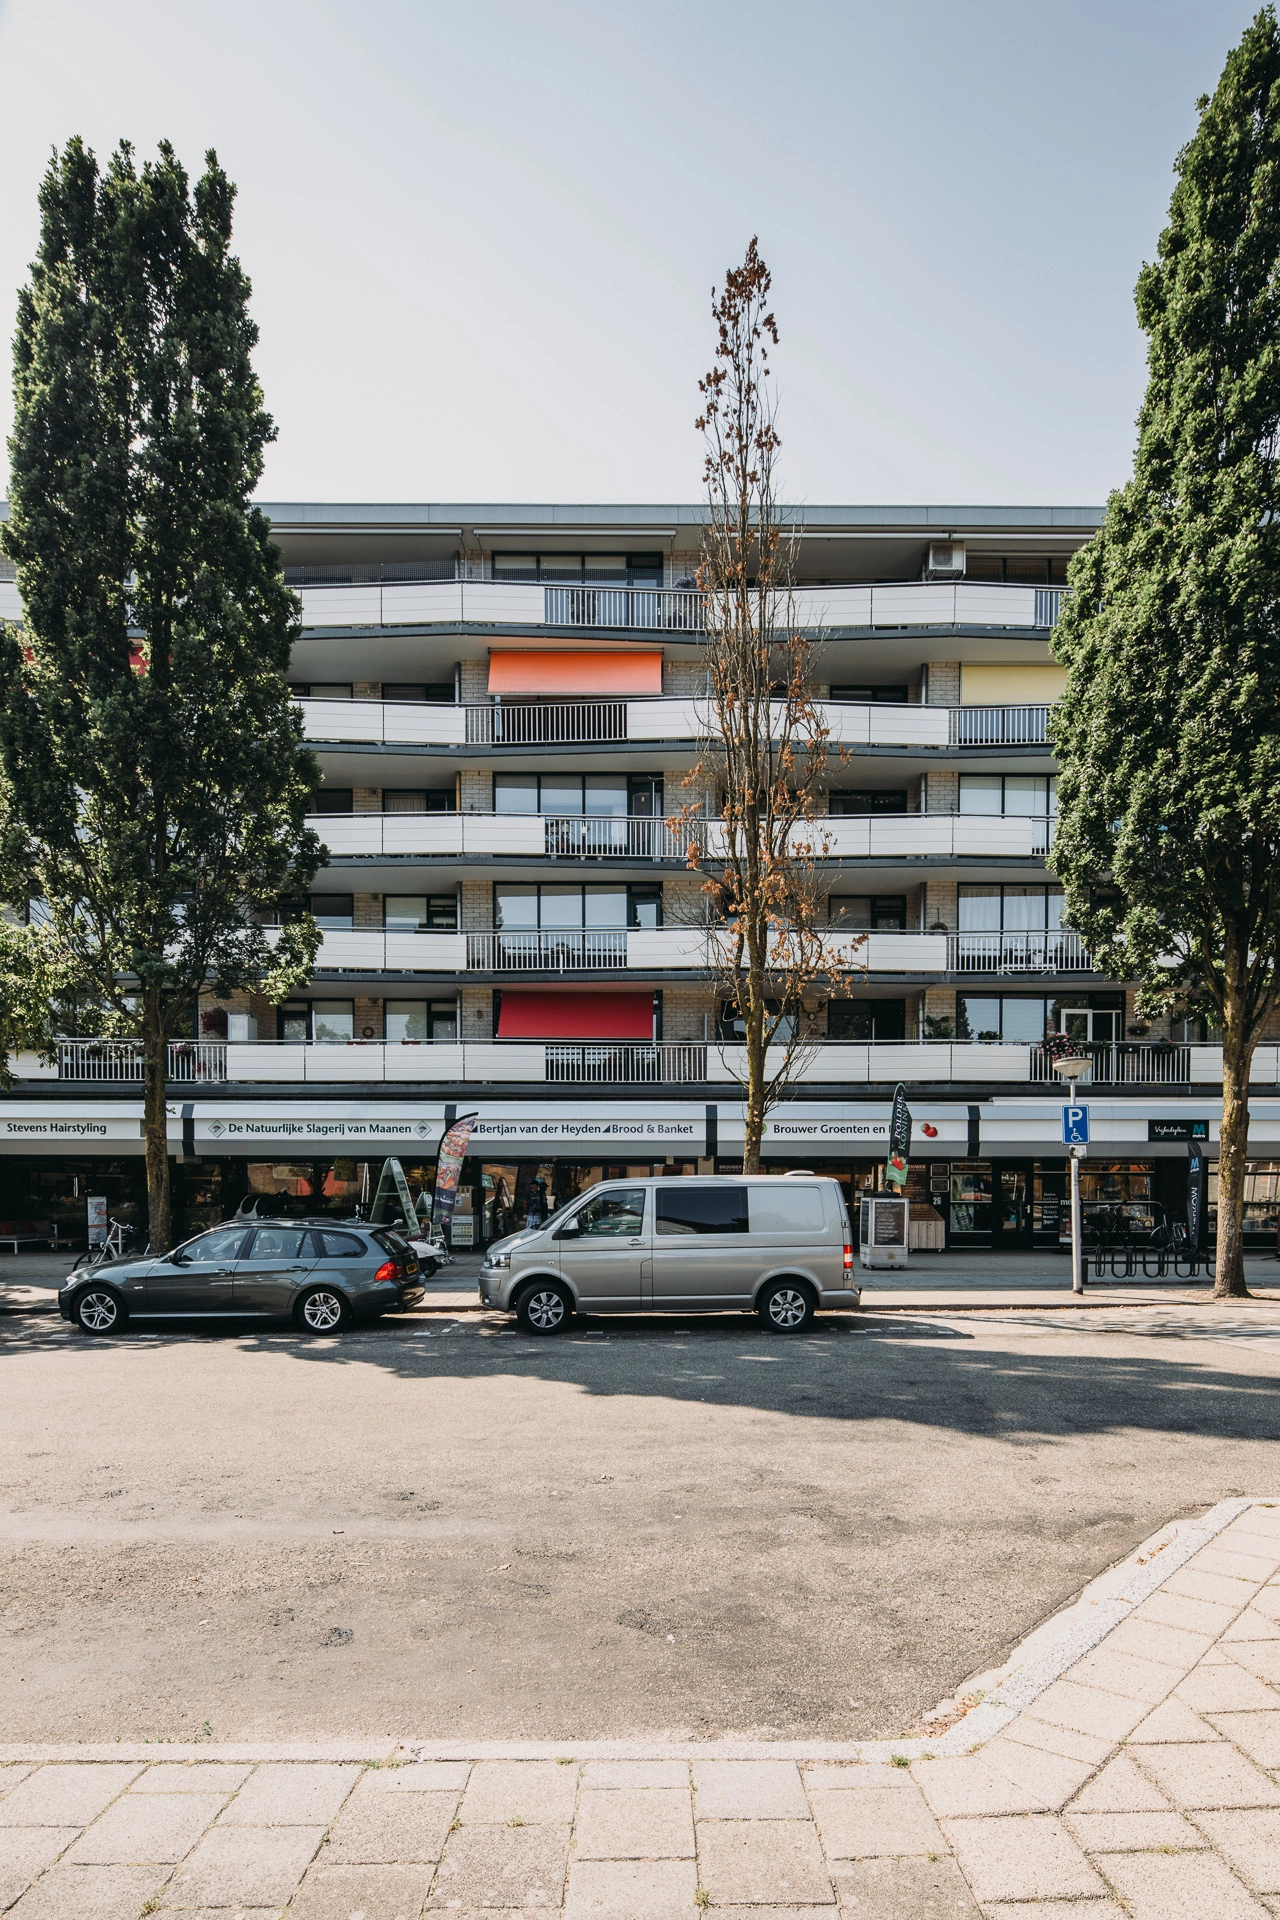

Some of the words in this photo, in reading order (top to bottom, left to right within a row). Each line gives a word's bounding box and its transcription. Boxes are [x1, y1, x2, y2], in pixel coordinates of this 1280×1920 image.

[894, 1096, 903, 1139] POLDER
[1068, 1108, 1083, 1128] P
[6, 1122, 48, 1133] Stevens
[50, 1122, 107, 1135] Hairstyling
[228, 1123, 243, 1133] De
[246, 1123, 304, 1136] Natuurlijke
[306, 1123, 345, 1136] Slagerij
[347, 1125, 367, 1133] van
[369, 1123, 412, 1133] Maanen
[479, 1123, 517, 1136] Bertjan
[519, 1126, 539, 1134] van
[541, 1123, 559, 1134] der
[561, 1123, 601, 1136] Heyden
[612, 1123, 644, 1134] Brood
[646, 1124, 656, 1134] &
[657, 1123, 694, 1134] Banket
[773, 1124, 819, 1134] Brouwer
[820, 1124, 870, 1134] Groenten
[872, 1126, 886, 1134] en
[932, 1196, 942, 1205] 26
